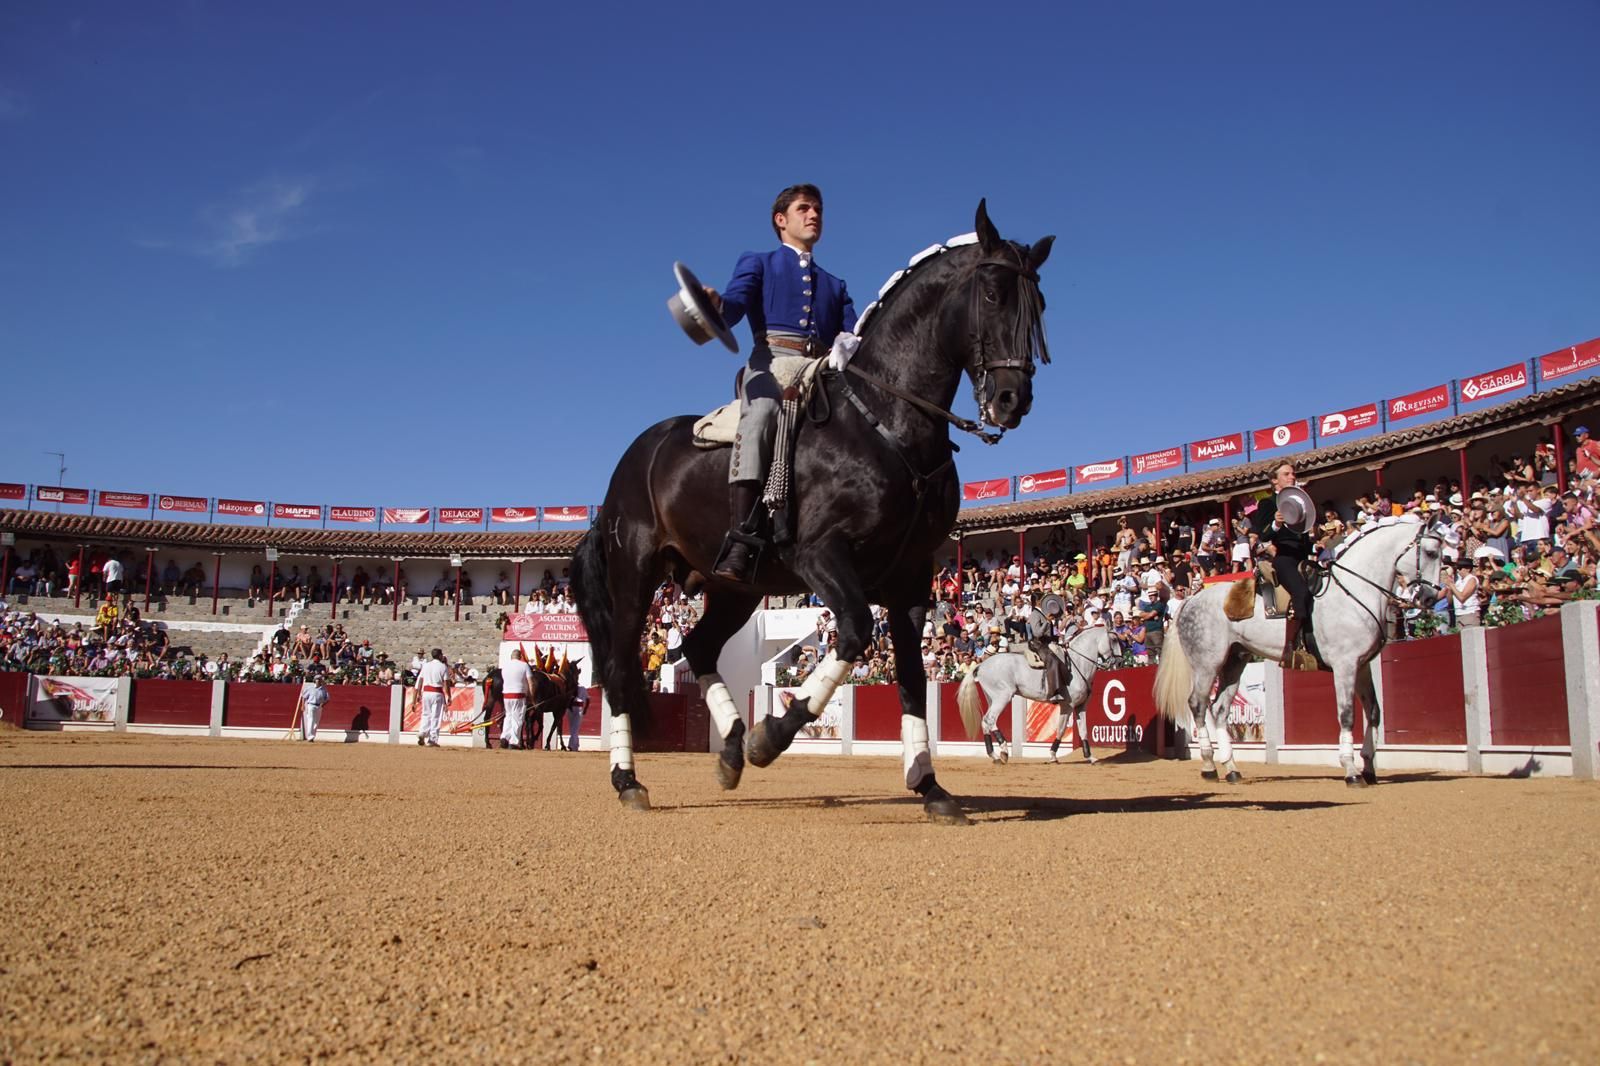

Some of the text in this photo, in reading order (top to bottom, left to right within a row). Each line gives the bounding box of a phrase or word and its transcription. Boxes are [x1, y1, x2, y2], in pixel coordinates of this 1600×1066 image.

[1480, 370, 1525, 391] GARBLA
[1408, 394, 1445, 411] REVISAN
[1197, 440, 1237, 458] MAJUMA
[285, 507, 320, 516] MAPFRE
[331, 509, 375, 518] CLAUDINO
[539, 615, 580, 623] ASOCIACIÓ
[544, 623, 576, 631] TAURINA
[1102, 679, 1126, 722] G
[1092, 724, 1143, 742] GUIJUELO
